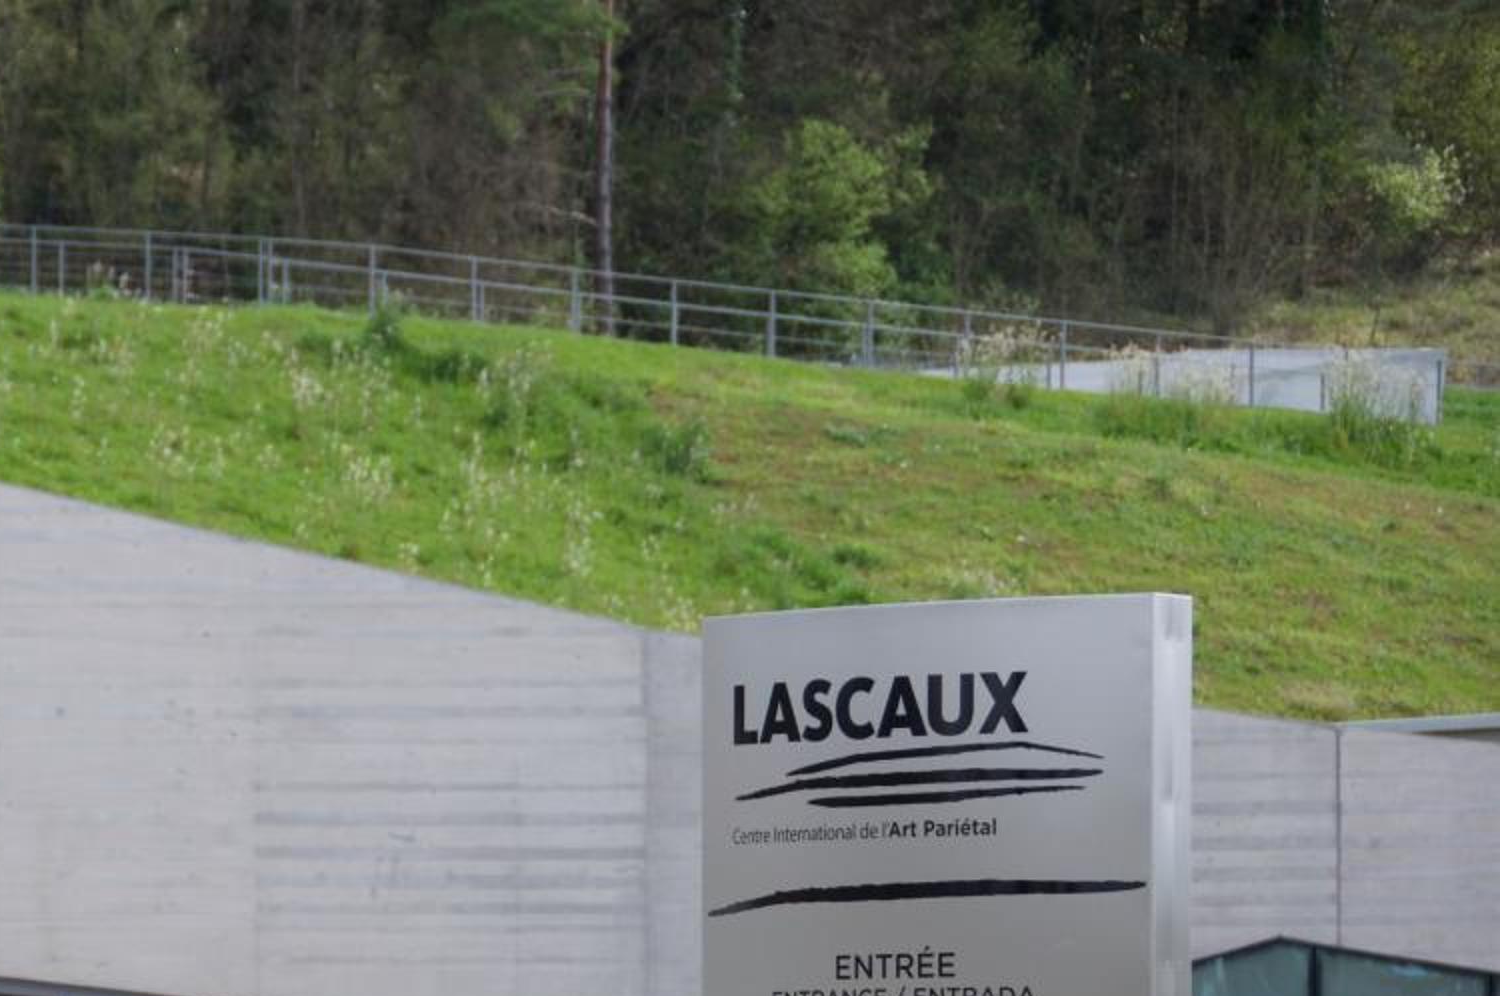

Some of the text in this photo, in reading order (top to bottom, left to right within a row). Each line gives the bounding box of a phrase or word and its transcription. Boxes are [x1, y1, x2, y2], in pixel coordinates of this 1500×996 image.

[733, 671, 1028, 745] LASCAUX
[733, 827, 770, 845] Centre
[774, 824, 856, 843] International
[860, 823, 879, 839] de
[923, 818, 997, 837] Pariétal
[835, 946, 956, 980] ENTRÉE
